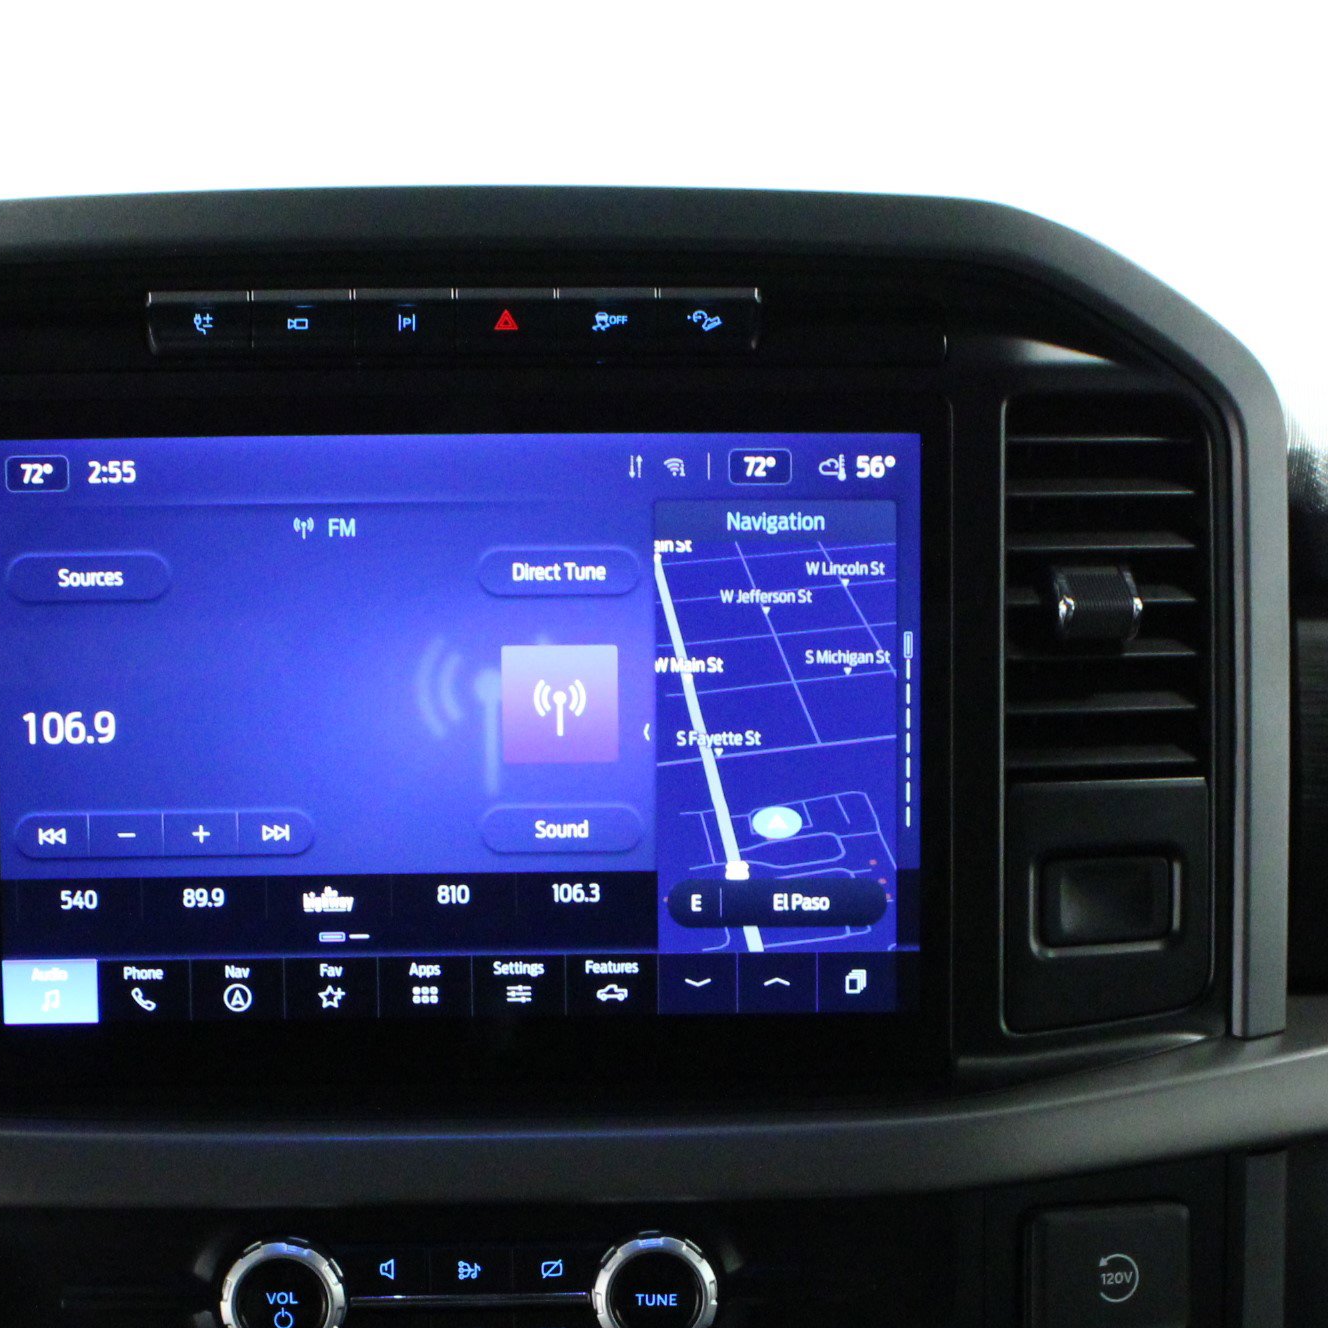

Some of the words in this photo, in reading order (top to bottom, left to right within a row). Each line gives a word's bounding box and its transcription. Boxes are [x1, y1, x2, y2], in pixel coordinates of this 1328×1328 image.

[608, 314, 629, 325] OFF
[19, 463, 54, 485] 72°
[87, 460, 137, 485] 2:55
[743, 455, 776, 477] 72°
[855, 454, 897, 479] 56°
[328, 518, 356, 538] FM
[726, 511, 826, 535] Navigation
[57, 567, 124, 588] Sources
[511, 562, 561, 582] Direct
[565, 562, 607, 582] Tune
[805, 562, 820, 576] W
[821, 561, 868, 577] Lincoln
[869, 561, 886, 576] St
[720, 589, 734, 603] W
[735, 588, 794, 604] Jefferson
[797, 589, 813, 603] St
[654, 657, 669, 673] W
[670, 656, 706, 673] Main
[706, 656, 724, 673] St
[805, 650, 815, 664] S
[815, 649, 873, 667] Michigan
[875, 649, 891, 664] St
[21, 710, 117, 746] 106.9
[675, 730, 686, 747] S
[688, 730, 744, 750] Fayette
[745, 730, 762, 747] St
[534, 820, 589, 840] Sound
[59, 889, 98, 911] 540
[182, 887, 225, 909] 89.9
[436, 884, 471, 905] 810
[551, 882, 601, 905] 106.3
[690, 893, 702, 912] E
[773, 893, 789, 912] El
[790, 893, 831, 912] Paso
[123, 966, 164, 984] Phone
[224, 964, 250, 980] Nav
[319, 963, 343, 979] Fav
[409, 962, 441, 981] Apps
[492, 959, 545, 981] Settings
[584, 958, 640, 976] Features
[1100, 1271, 1134, 1286] 120V
[265, 1292, 299, 1306] VOL
[635, 1294, 678, 1307] TUNE
